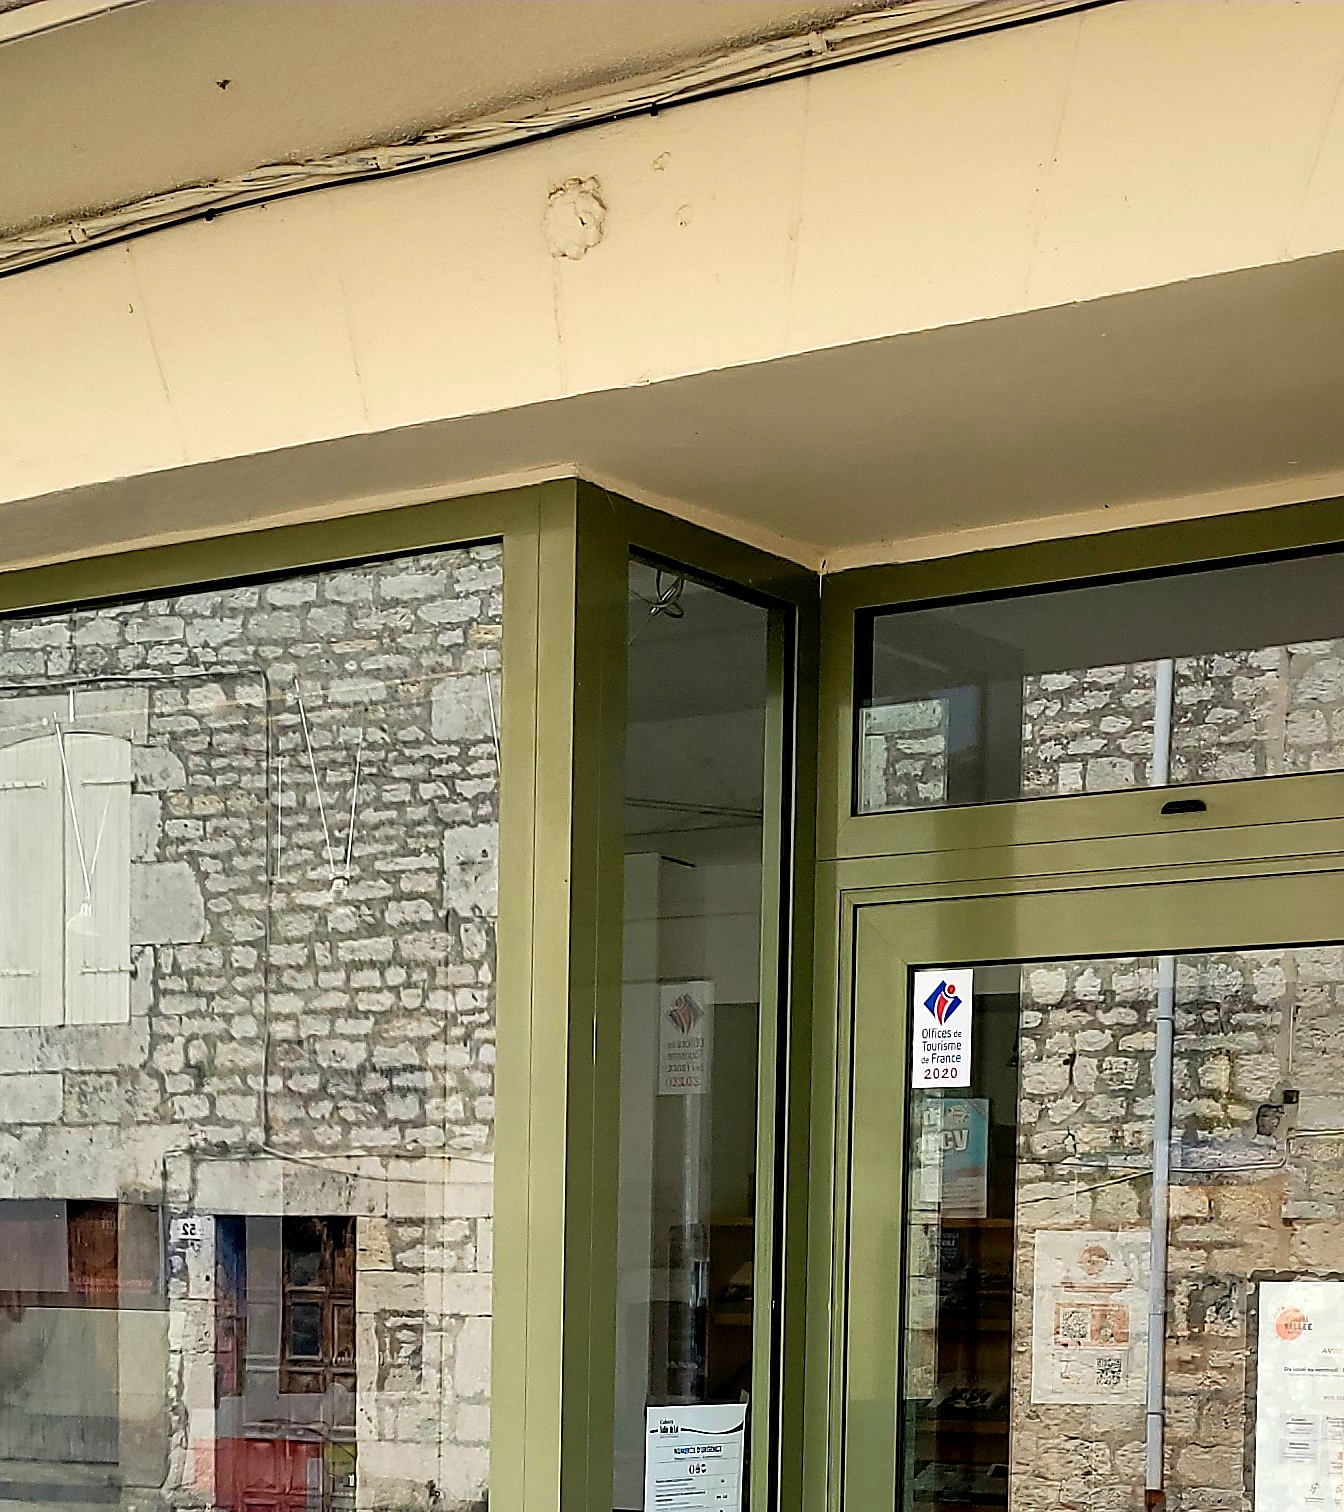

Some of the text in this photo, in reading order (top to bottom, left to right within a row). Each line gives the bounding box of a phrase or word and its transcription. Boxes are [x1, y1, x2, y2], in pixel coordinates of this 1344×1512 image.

[921, 1028, 952, 1039] Offices
[921, 1041, 962, 1052] Tourisme
[931, 1053, 962, 1064] France
[924, 1067, 958, 1080] 2020
